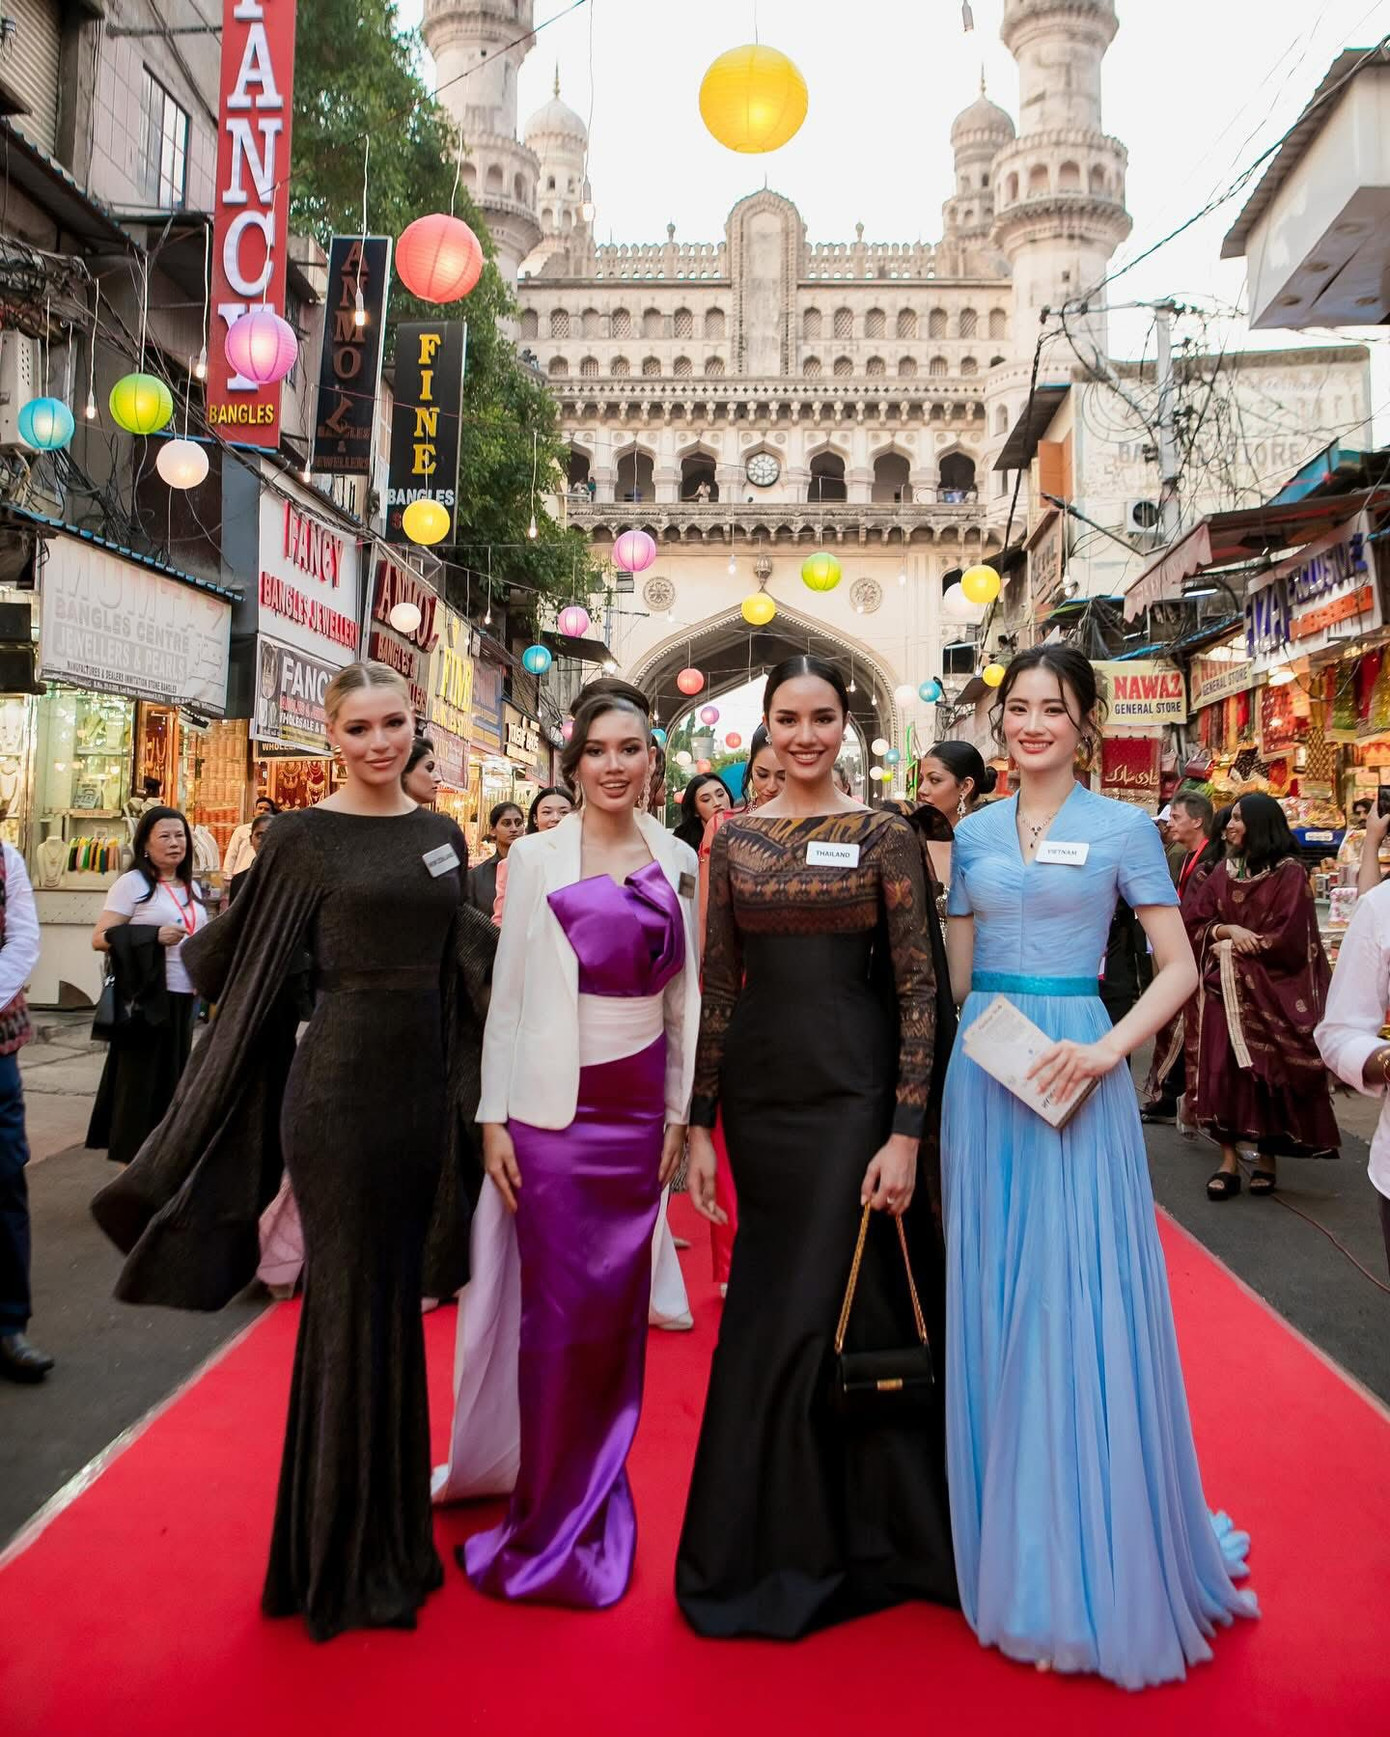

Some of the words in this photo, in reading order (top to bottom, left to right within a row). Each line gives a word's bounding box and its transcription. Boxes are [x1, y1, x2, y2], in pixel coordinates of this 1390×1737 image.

[217, 0, 284, 390] ANC
[208, 404, 275, 424] BANGLES
[411, 333, 442, 475] FINE
[283, 500, 343, 589] FANCY
[260, 571, 309, 627] BANGLES
[54, 597, 131, 637] BANGLES
[136, 621, 190, 654] CENTRE
[281, 655, 334, 705] FANC
[1113, 672, 1183, 700] NAWAZ
[1114, 703, 1153, 715] GENERAL
[1156, 702, 1182, 714] STORE
[815, 849, 851, 858] THAILAND
[1047, 848, 1078, 856] VIETNAM
